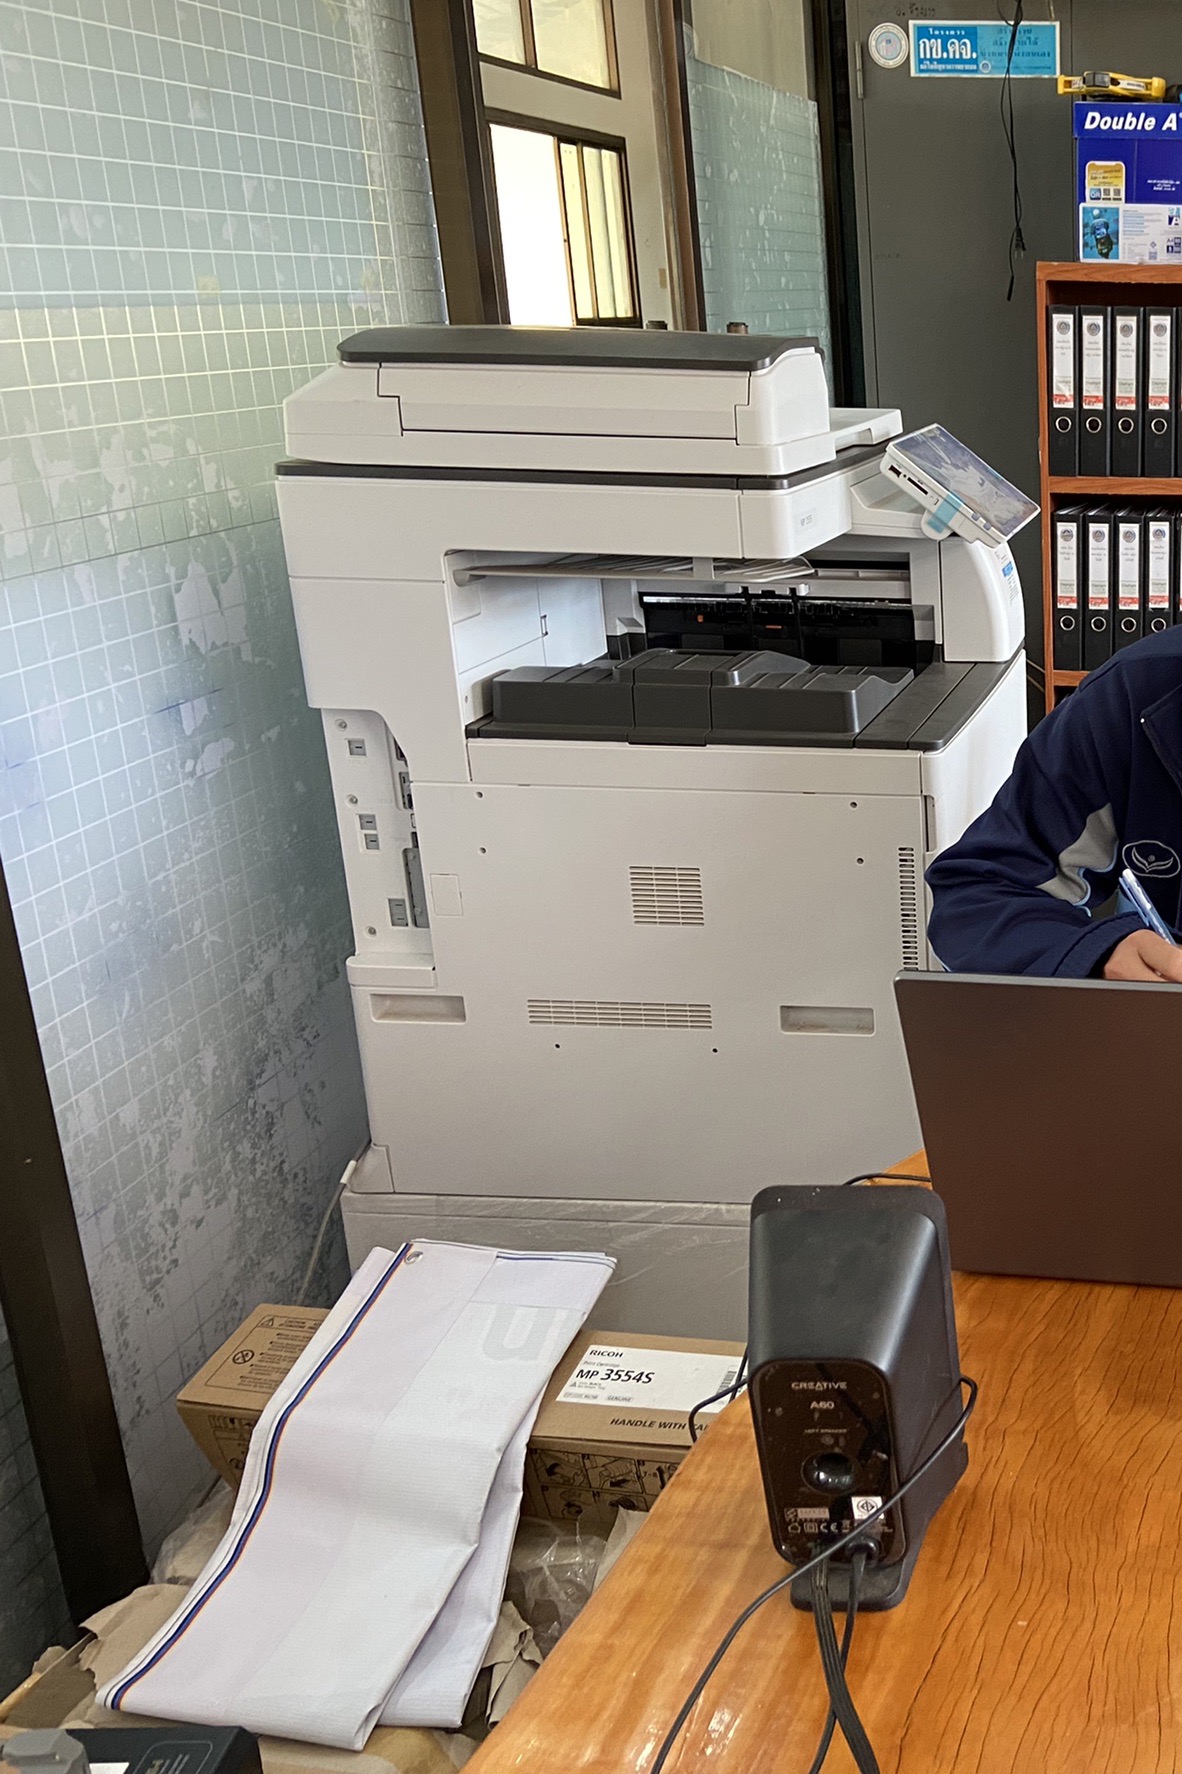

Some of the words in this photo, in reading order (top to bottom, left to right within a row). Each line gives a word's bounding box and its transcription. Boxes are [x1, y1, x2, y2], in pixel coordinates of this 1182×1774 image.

[919, 38, 977, 59] กข.คจ.
[1084, 111, 1156, 131] Double
[1161, 112, 1178, 131] A
[589, 1349, 624, 1358] RICOH
[576, 1369, 599, 1380] MP
[600, 1368, 655, 1384] 3554S
[791, 1381, 847, 1391] CREATIVE
[810, 1400, 835, 1410] A60
[610, 1417, 655, 1429] HANDLE
[658, 1421, 687, 1431] WITH
